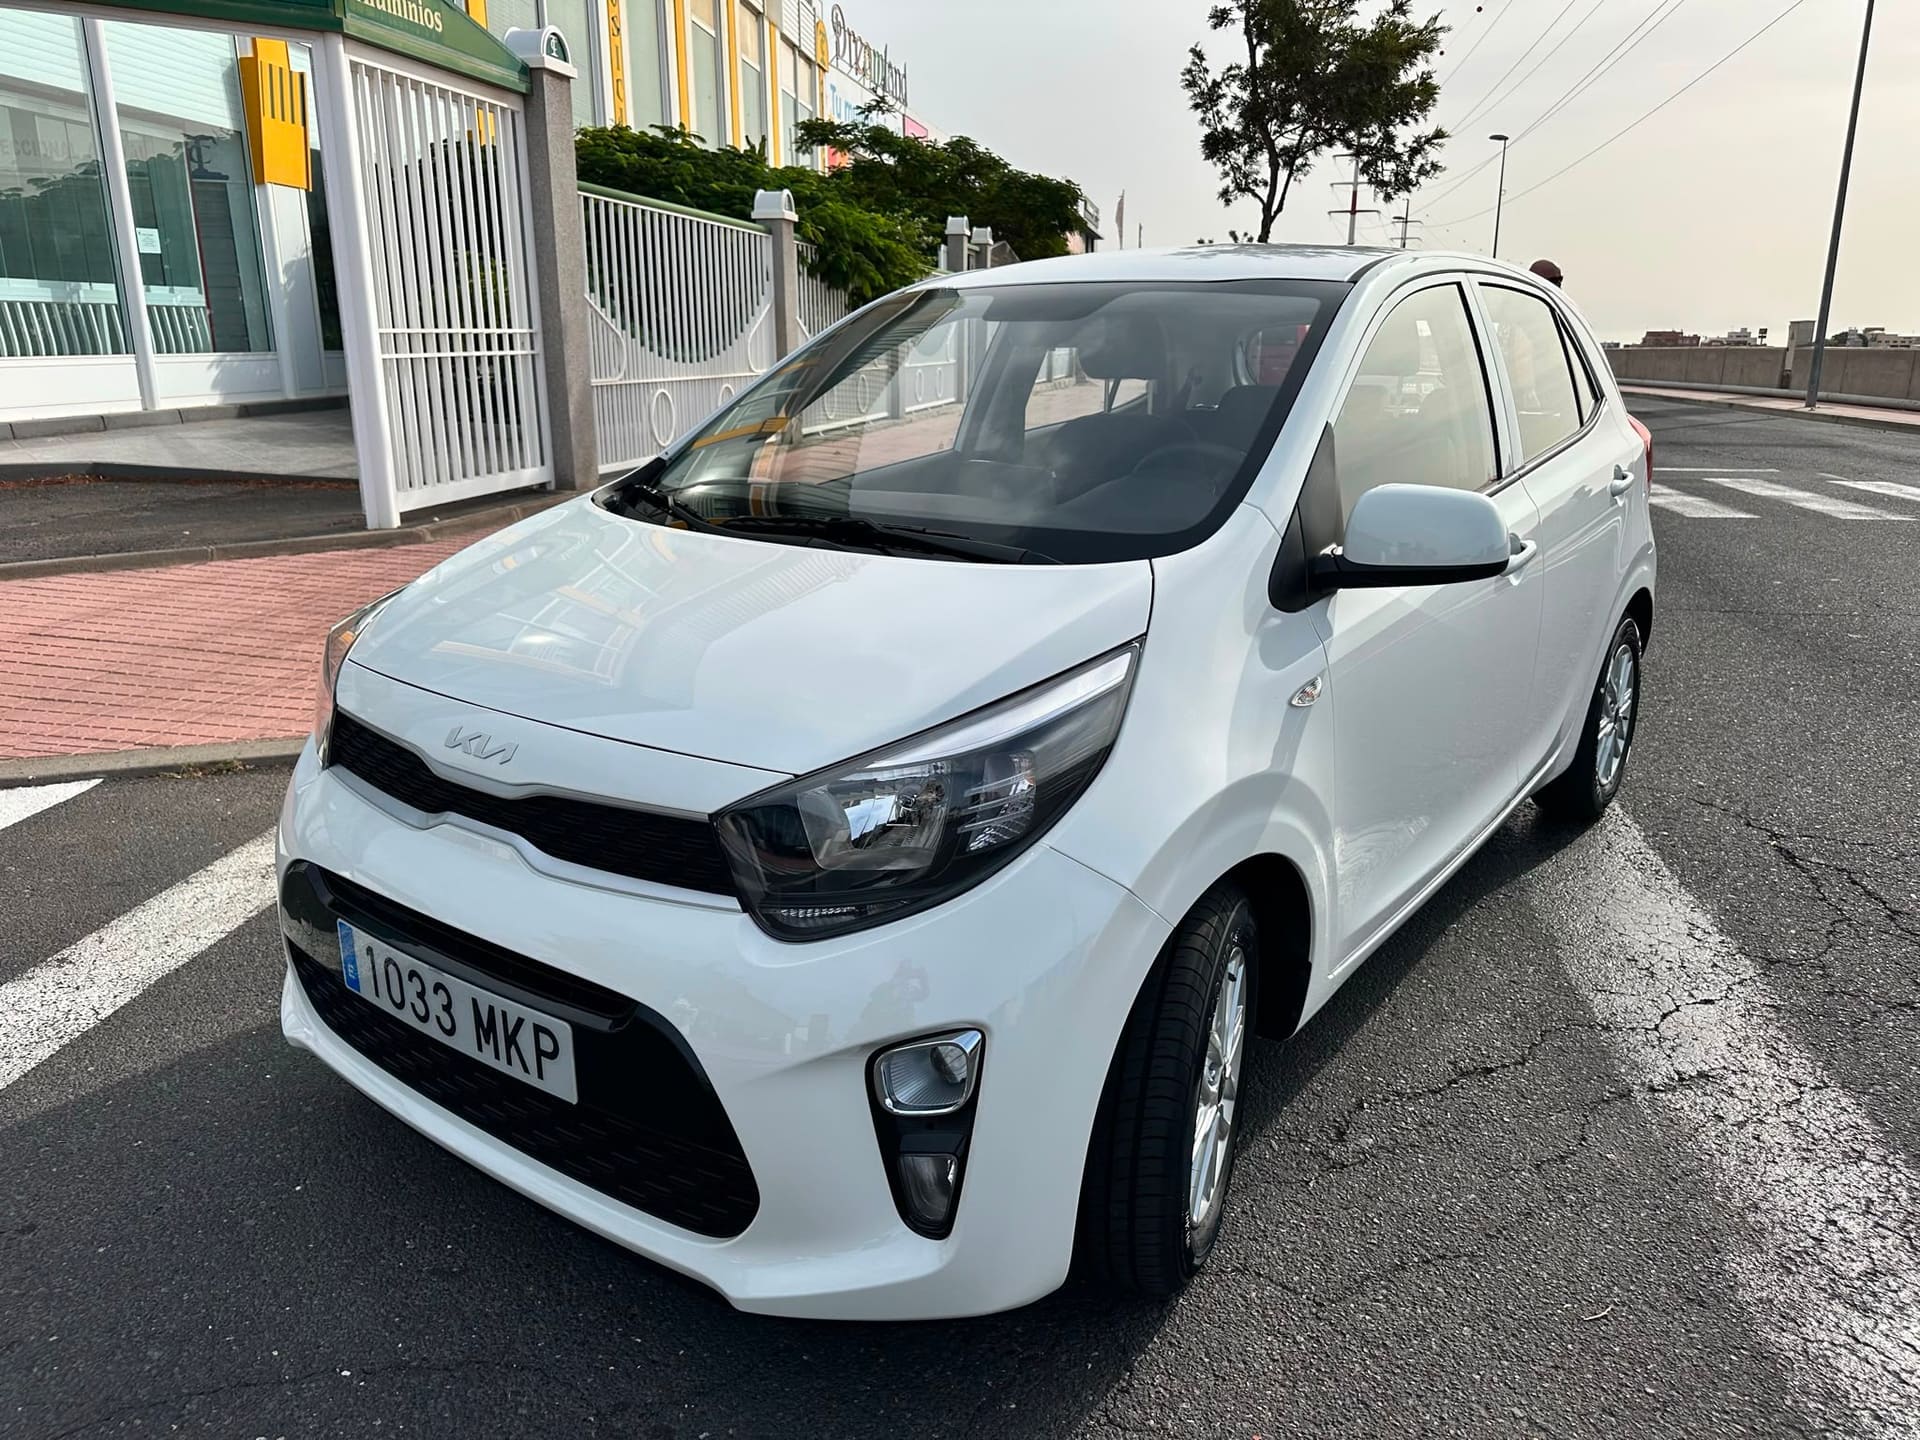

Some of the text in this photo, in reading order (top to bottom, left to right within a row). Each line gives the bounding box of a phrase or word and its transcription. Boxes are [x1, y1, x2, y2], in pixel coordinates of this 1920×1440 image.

[356, 0, 443, 33] uminios
[444, 725, 520, 766] KIA
[365, 945, 560, 1081] 1033 MKP
